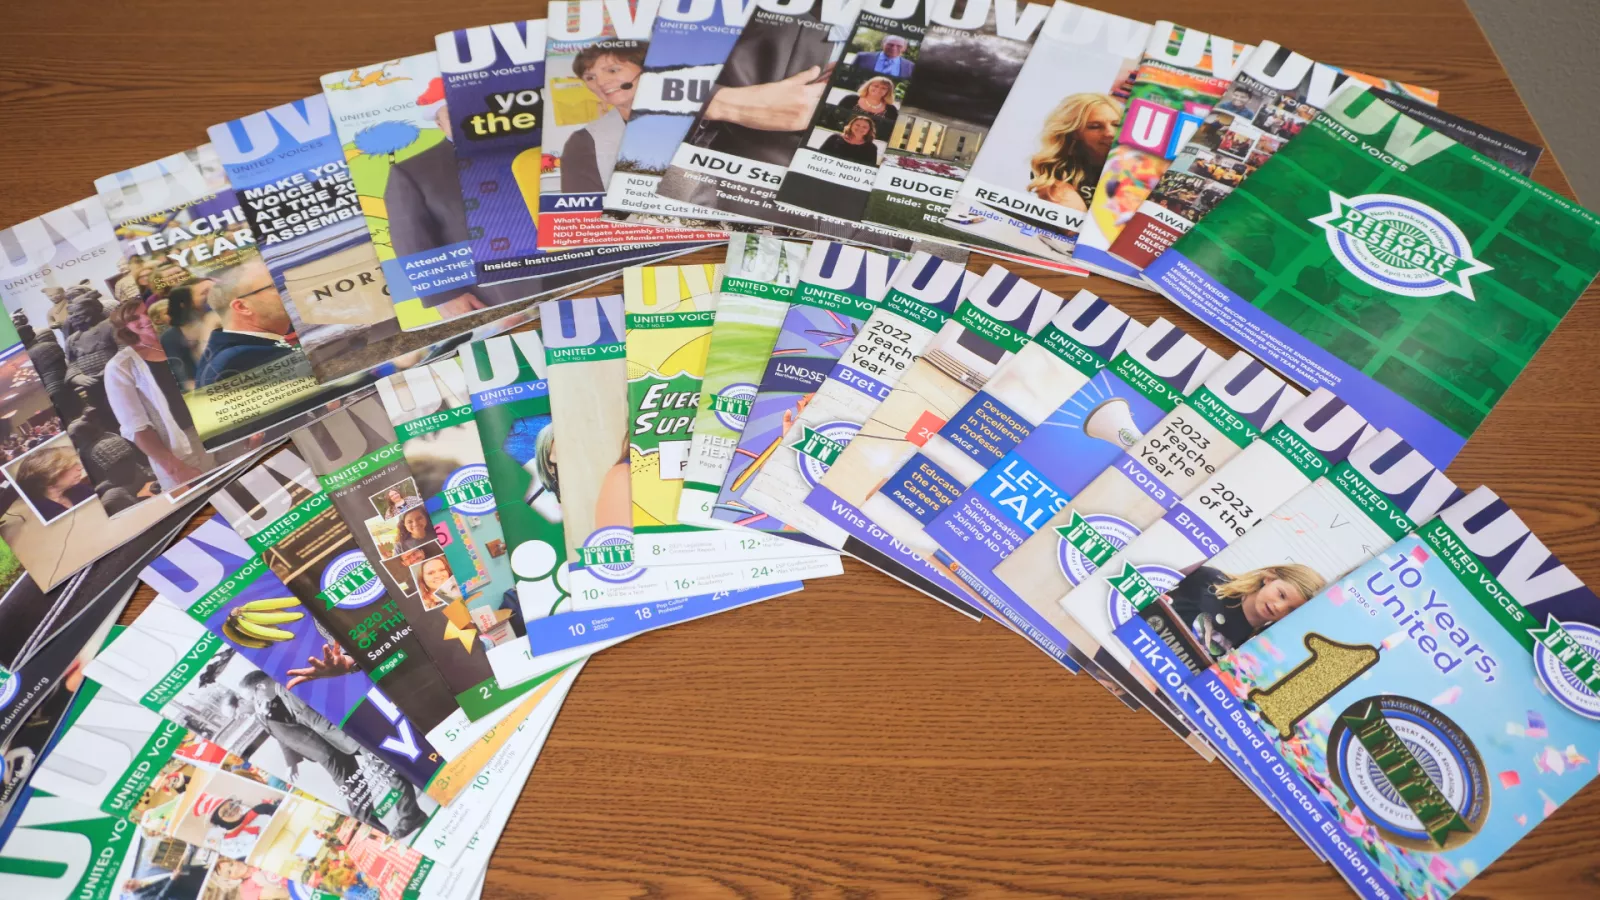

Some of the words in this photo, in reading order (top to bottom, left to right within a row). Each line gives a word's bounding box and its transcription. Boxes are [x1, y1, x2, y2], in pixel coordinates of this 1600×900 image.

[660, 21, 698, 31] UNITED
[701, 25, 742, 36] VOICES
[757, 11, 793, 24] UNITED
[861, 13, 898, 28] UNITED
[552, 41, 592, 49] UNITED
[594, 40, 638, 48] VOICES
[448, 70, 489, 83] UNITED
[491, 64, 536, 77] VOICES
[1238, 75, 1278, 98] UNITED
[340, 108, 381, 122] UNITED
[470, 113, 536, 135] the
[1317, 114, 1360, 145] UNITED
[1361, 142, 1409, 173] VOICES
[1409, 107, 1446, 126] publication
[1503, 142, 1528, 156] United
[232, 157, 275, 174] UNITED
[279, 140, 323, 160] VOICES
[690, 152, 744, 175] NDU
[811, 153, 834, 165] 2017
[835, 159, 862, 173] North
[1471, 154, 1497, 172] Serving
[627, 178, 653, 187] NDU
[683, 171, 718, 186] Inside:
[720, 179, 748, 193] State
[807, 163, 836, 177] Inside:
[838, 172, 861, 183] NDU
[244, 172, 305, 200] MAKE
[247, 182, 316, 211] VOICE
[255, 207, 283, 223] AT
[290, 188, 331, 212] THE
[553, 197, 597, 209] AMY
[621, 198, 661, 210] Budget
[664, 204, 689, 214] Cuts
[692, 207, 709, 216] Hit
[715, 189, 760, 208] Teachers
[886, 194, 921, 208] Inside:
[975, 187, 1059, 221] READING
[968, 206, 1003, 222] Inside:
[167, 228, 256, 268] YEAR
[1337, 221, 1452, 276] ASSEMBLY
[1345, 209, 1458, 268] DELEGATE
[5, 268, 51, 291] UNITED
[56, 247, 107, 271] VOICES
[405, 253, 447, 270] Attend
[484, 259, 521, 272] Inside:
[525, 248, 594, 266] Instructional
[433, 273, 467, 288] United
[727, 279, 769, 292] UNITED
[1176, 260, 1204, 284] WHAT'S
[1203, 281, 1231, 303] INSIDE:
[803, 286, 852, 305] UNITED
[892, 293, 938, 319] UNITED
[633, 314, 675, 324] UNITED
[966, 307, 1011, 337] UNITED
[1161, 275, 1192, 300] EDUCATION
[1190, 298, 1217, 319] SUPPORT
[1215, 315, 1259, 347] PROFESSIONAL
[1295, 366, 1320, 385] NAMED
[1170, 267, 1202, 294] LEGISLATIVE
[1201, 289, 1224, 308] VOTING
[1222, 305, 1247, 323] RECORD
[1260, 330, 1293, 353] CANDIDATE
[1293, 351, 1342, 383] ENDORSEMENTS
[872, 320, 912, 344] 2022
[1177, 280, 1204, 302] MEMBERS
[1204, 297, 1231, 319] SELECTED
[1243, 324, 1267, 341] HIGHER
[1265, 338, 1300, 363] EDUCATION
[1314, 371, 1337, 387] FORCE
[553, 347, 596, 358] UNITED
[857, 344, 876, 357] of
[878, 350, 906, 372] the
[1049, 331, 1093, 364] UNITED
[850, 353, 886, 377] Year
[1121, 359, 1166, 393] UNITED
[206, 373, 260, 396] SPECIAL
[838, 368, 876, 393] Bret
[479, 386, 524, 402] UNITED
[404, 414, 449, 432] UNITED
[1200, 393, 1244, 430] UNITED
[967, 416, 978, 426] In
[980, 422, 1003, 442] Your
[1170, 416, 1211, 450] 2023
[950, 433, 972, 450] PAGE
[1278, 428, 1323, 469] UNITED
[1140, 446, 1175, 478] Year
[1149, 439, 1170, 454] of
[1171, 451, 1196, 478] the
[324, 460, 369, 486] UNITED
[362, 470, 387, 485] United
[911, 471, 929, 487] the
[1122, 459, 1166, 501] Ivona
[893, 489, 916, 509] PAGE
[903, 480, 941, 511] Careers
[1210, 482, 1253, 518] 2023
[1343, 469, 1388, 511] UNITED
[700, 501, 709, 512] 6
[1199, 495, 1218, 510] of
[1219, 509, 1246, 537] the
[256, 511, 300, 544] UNITED
[831, 499, 867, 528] Wins
[869, 522, 893, 541] for
[944, 519, 963, 537] PAGE
[953, 511, 985, 542] Joining
[984, 538, 1000, 553] ND
[962, 504, 993, 533] Talking
[992, 527, 1003, 540] to
[740, 539, 756, 550] 12
[1174, 512, 1220, 554] Bruce
[652, 544, 661, 556] 8
[674, 578, 690, 590] 16
[751, 567, 769, 579] 24
[1435, 525, 1479, 574] UNITED
[1478, 570, 1525, 622] VOICES
[193, 580, 236, 615] UNITED
[582, 588, 599, 601] 10
[1347, 585, 1372, 609] page
[348, 611, 383, 640] 2020
[634, 607, 653, 621] 18
[1367, 571, 1462, 674] United
[1388, 553, 1422, 588] 10
[1422, 589, 1498, 683] Years,
[568, 623, 586, 637] 10
[591, 616, 615, 626] Election
[1002, 606, 1030, 634] COGNITIVE
[1027, 627, 1065, 660] ENGAGEMENT
[358, 631, 379, 649] OF
[367, 642, 392, 661] Sara
[1556, 628, 1592, 663] NORTH
[379, 658, 398, 673] Page
[146, 663, 189, 703] UNITED
[479, 685, 492, 700] 2
[1, 676, 50, 731] ndunited.org
[444, 729, 457, 742] 5
[109, 760, 151, 810] UNITED
[472, 774, 490, 793] 10
[1205, 680, 1234, 709] NDU
[1230, 709, 1265, 749] Board
[1260, 749, 1278, 766] of
[1272, 763, 1323, 823] Directors
[1320, 820, 1369, 877] Election
[375, 798, 392, 816] Page
[408, 859, 428, 892] What's
